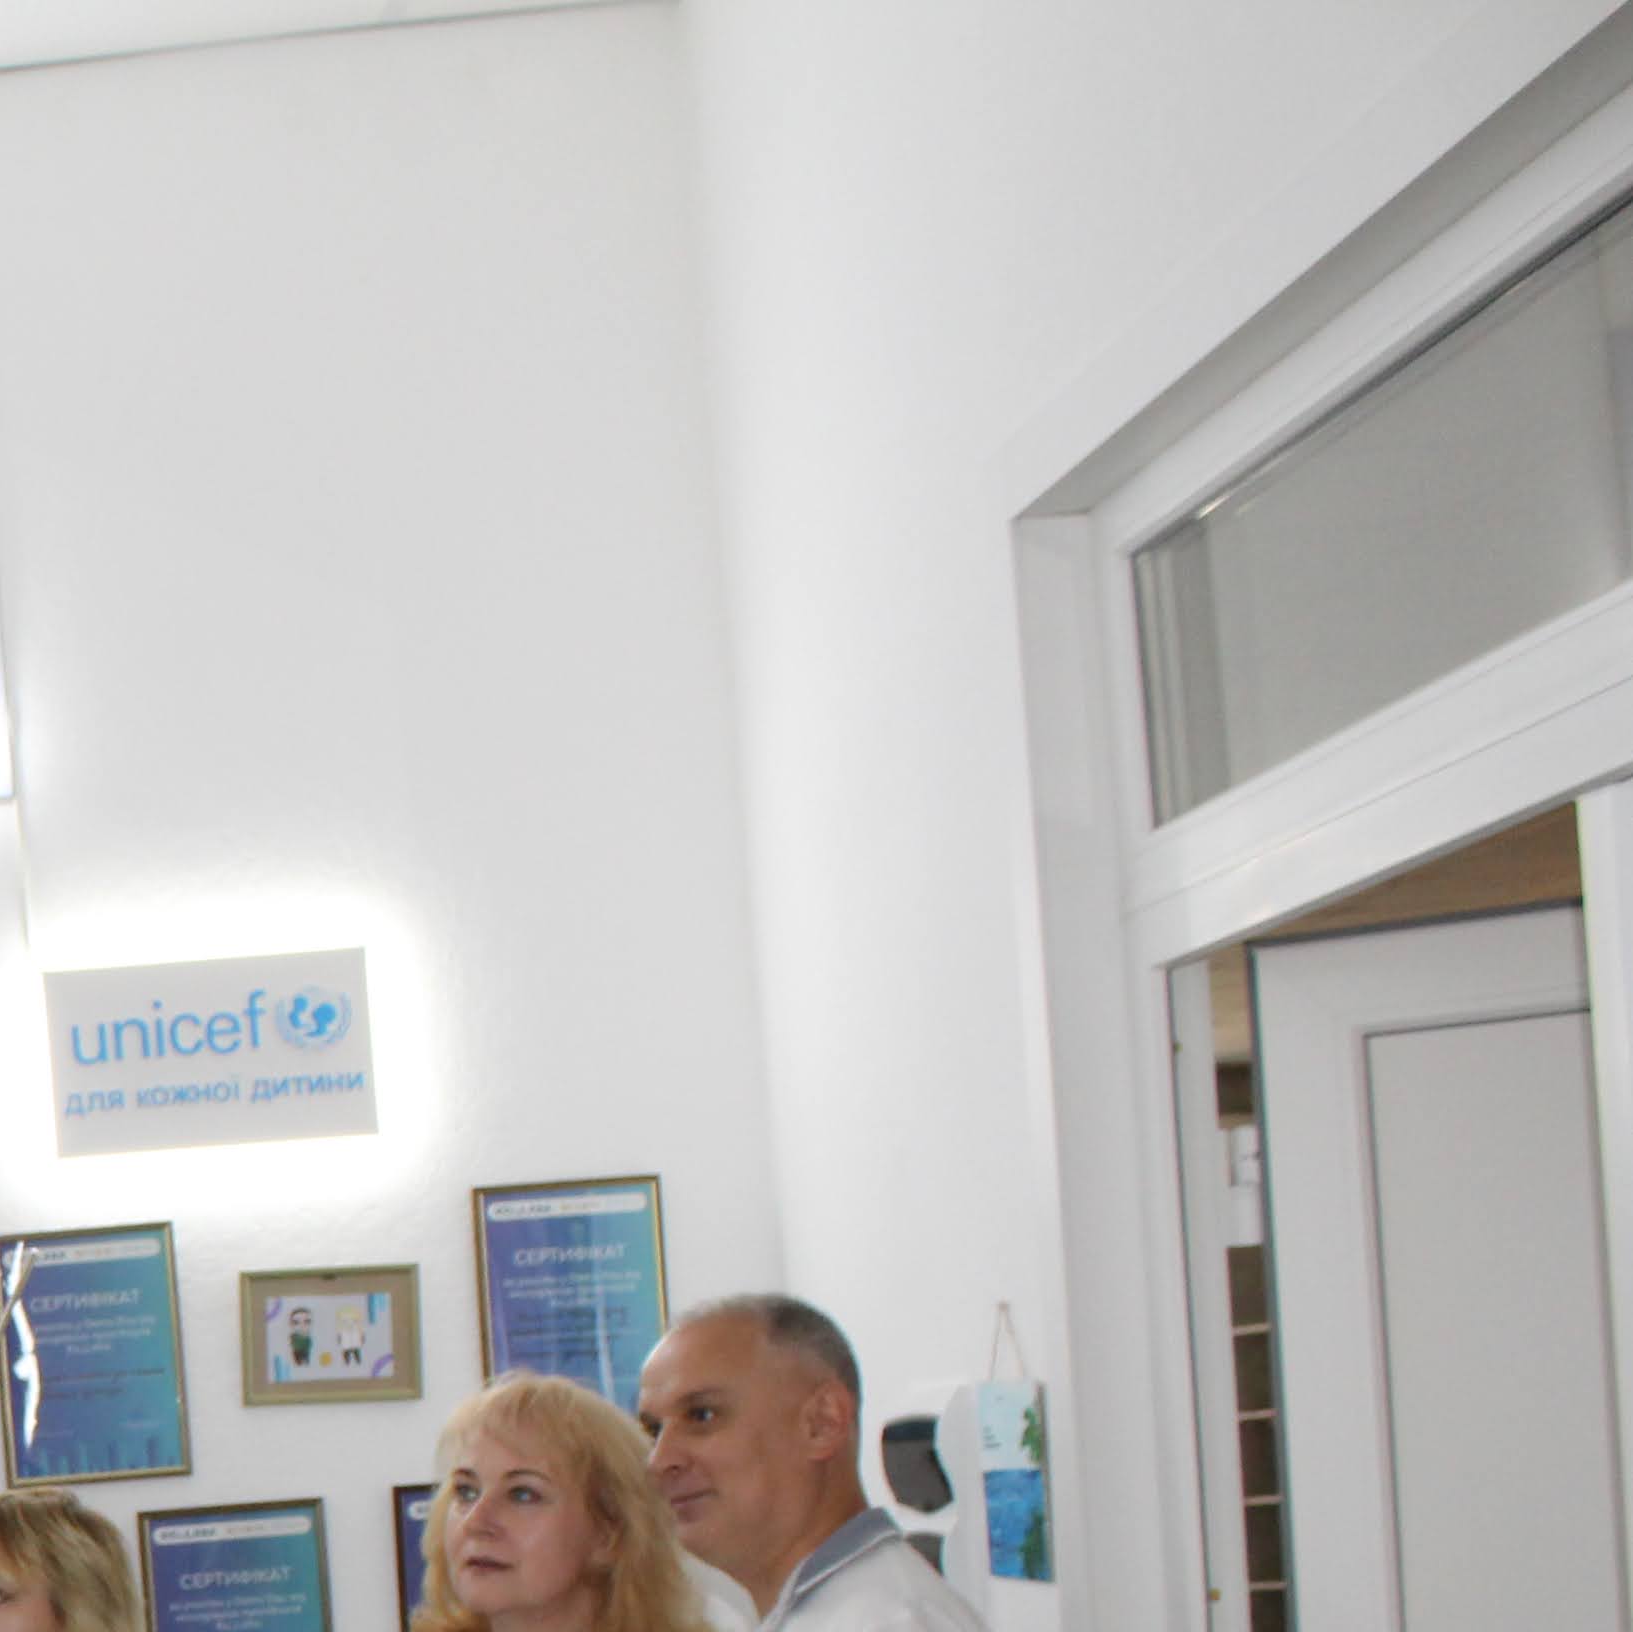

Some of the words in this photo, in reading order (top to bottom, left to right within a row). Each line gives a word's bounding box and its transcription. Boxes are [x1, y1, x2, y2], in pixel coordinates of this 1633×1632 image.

[70, 988, 268, 1066] unicef
[65, 1088, 126, 1117] для
[250, 1071, 365, 1104] дитини
